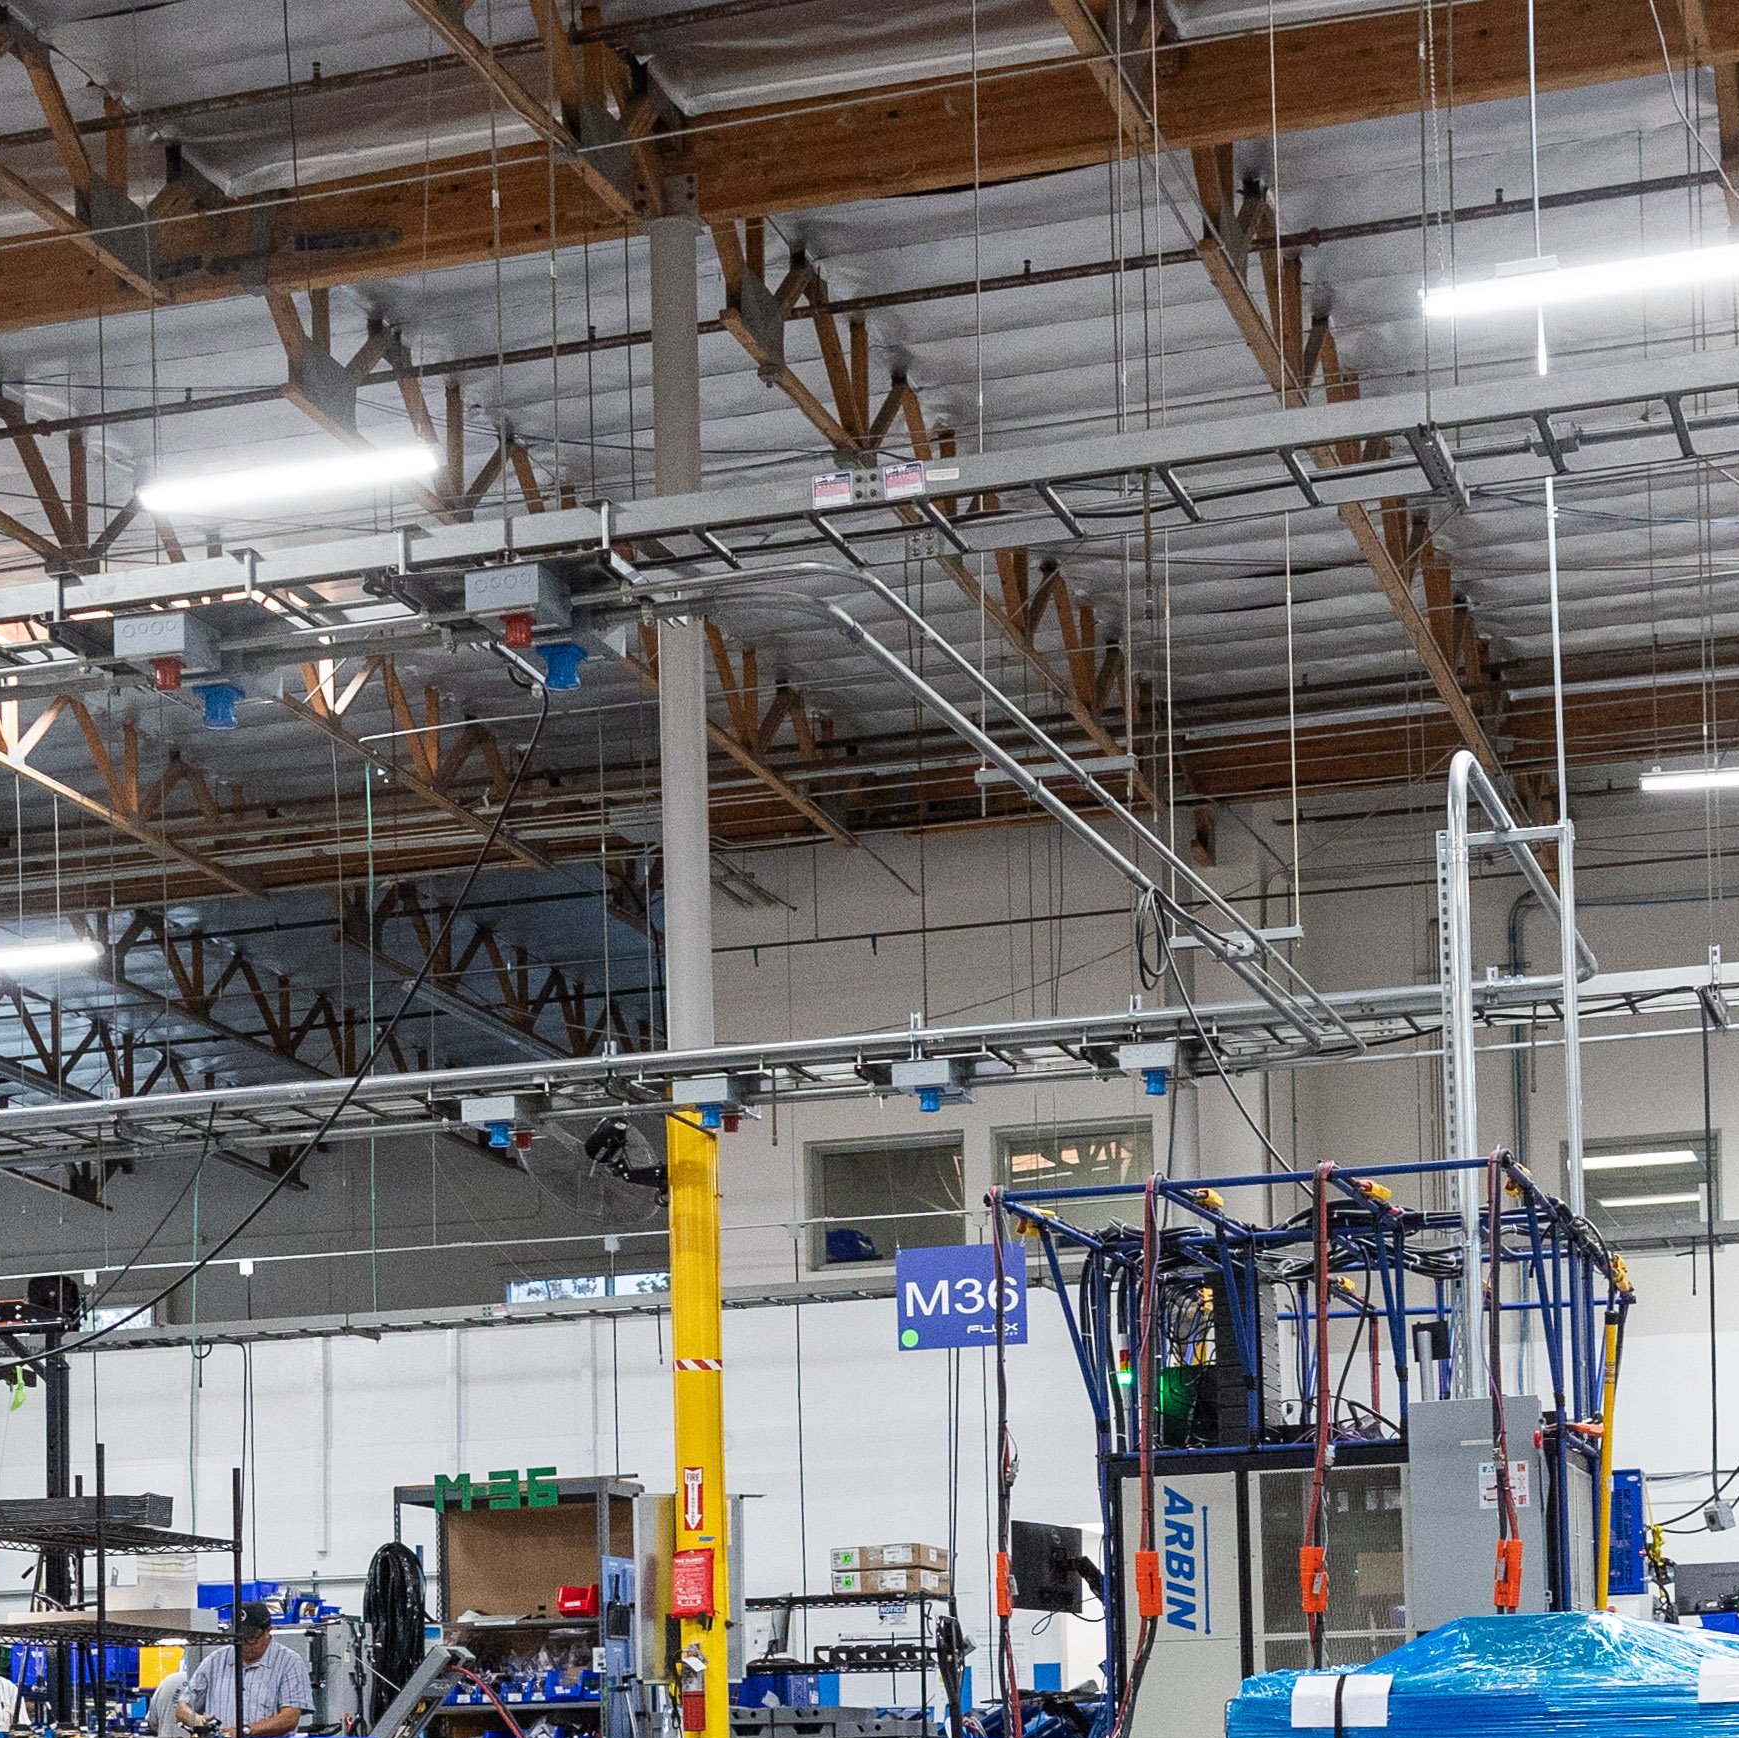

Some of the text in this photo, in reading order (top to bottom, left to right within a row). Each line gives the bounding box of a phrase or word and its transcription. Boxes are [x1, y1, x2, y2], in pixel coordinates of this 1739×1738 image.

[905, 1275, 1020, 1318] M36
[434, 1466, 559, 1513] M-36
[686, 1472, 700, 1482] FIRE
[1164, 1485, 1197, 1632] ARBIN
[879, 1605, 907, 1614] NOTICE
